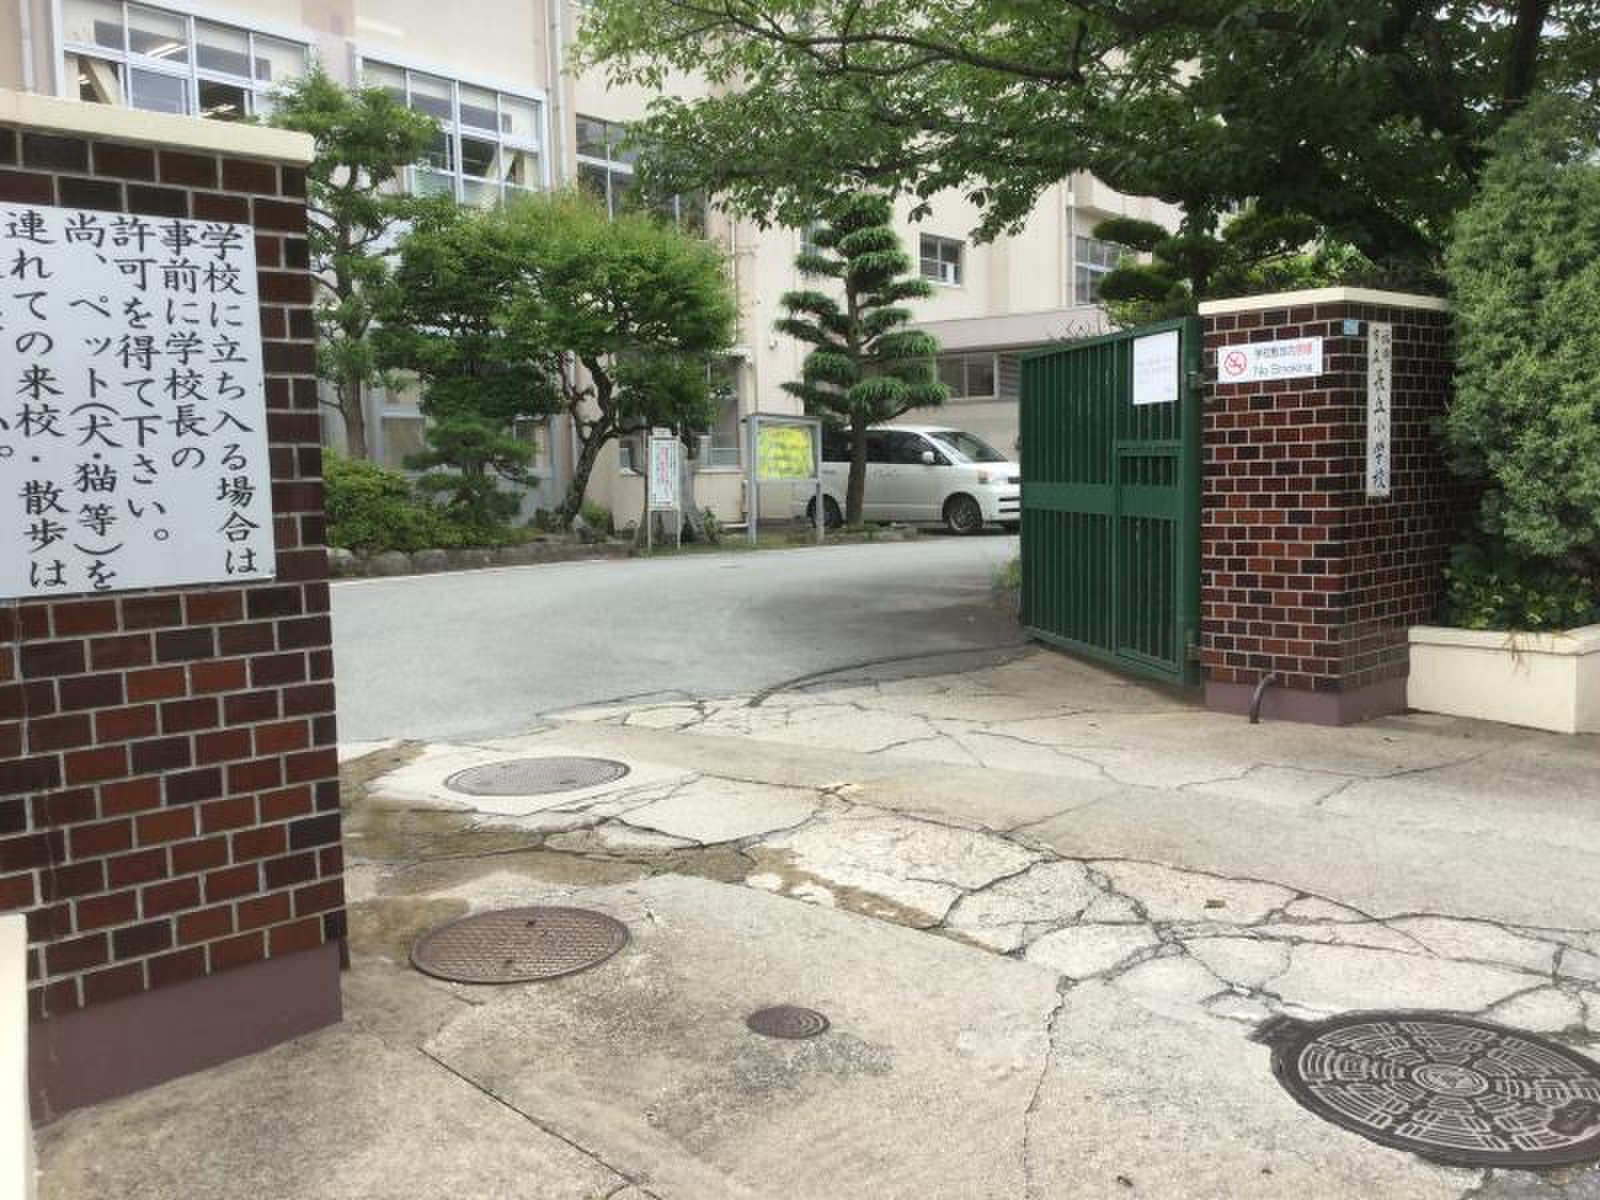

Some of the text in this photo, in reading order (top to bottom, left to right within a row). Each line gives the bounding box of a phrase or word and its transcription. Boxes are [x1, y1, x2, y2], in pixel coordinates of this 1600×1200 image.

[4, 209, 70, 589] 連れての来校・散歩は
[111, 216, 169, 542] 許可を得て下さい。
[158, 219, 209, 470] 事前に学校長の
[199, 223, 260, 576] 学校に立ち入る場合は
[1248, 364, 1269, 377] No
